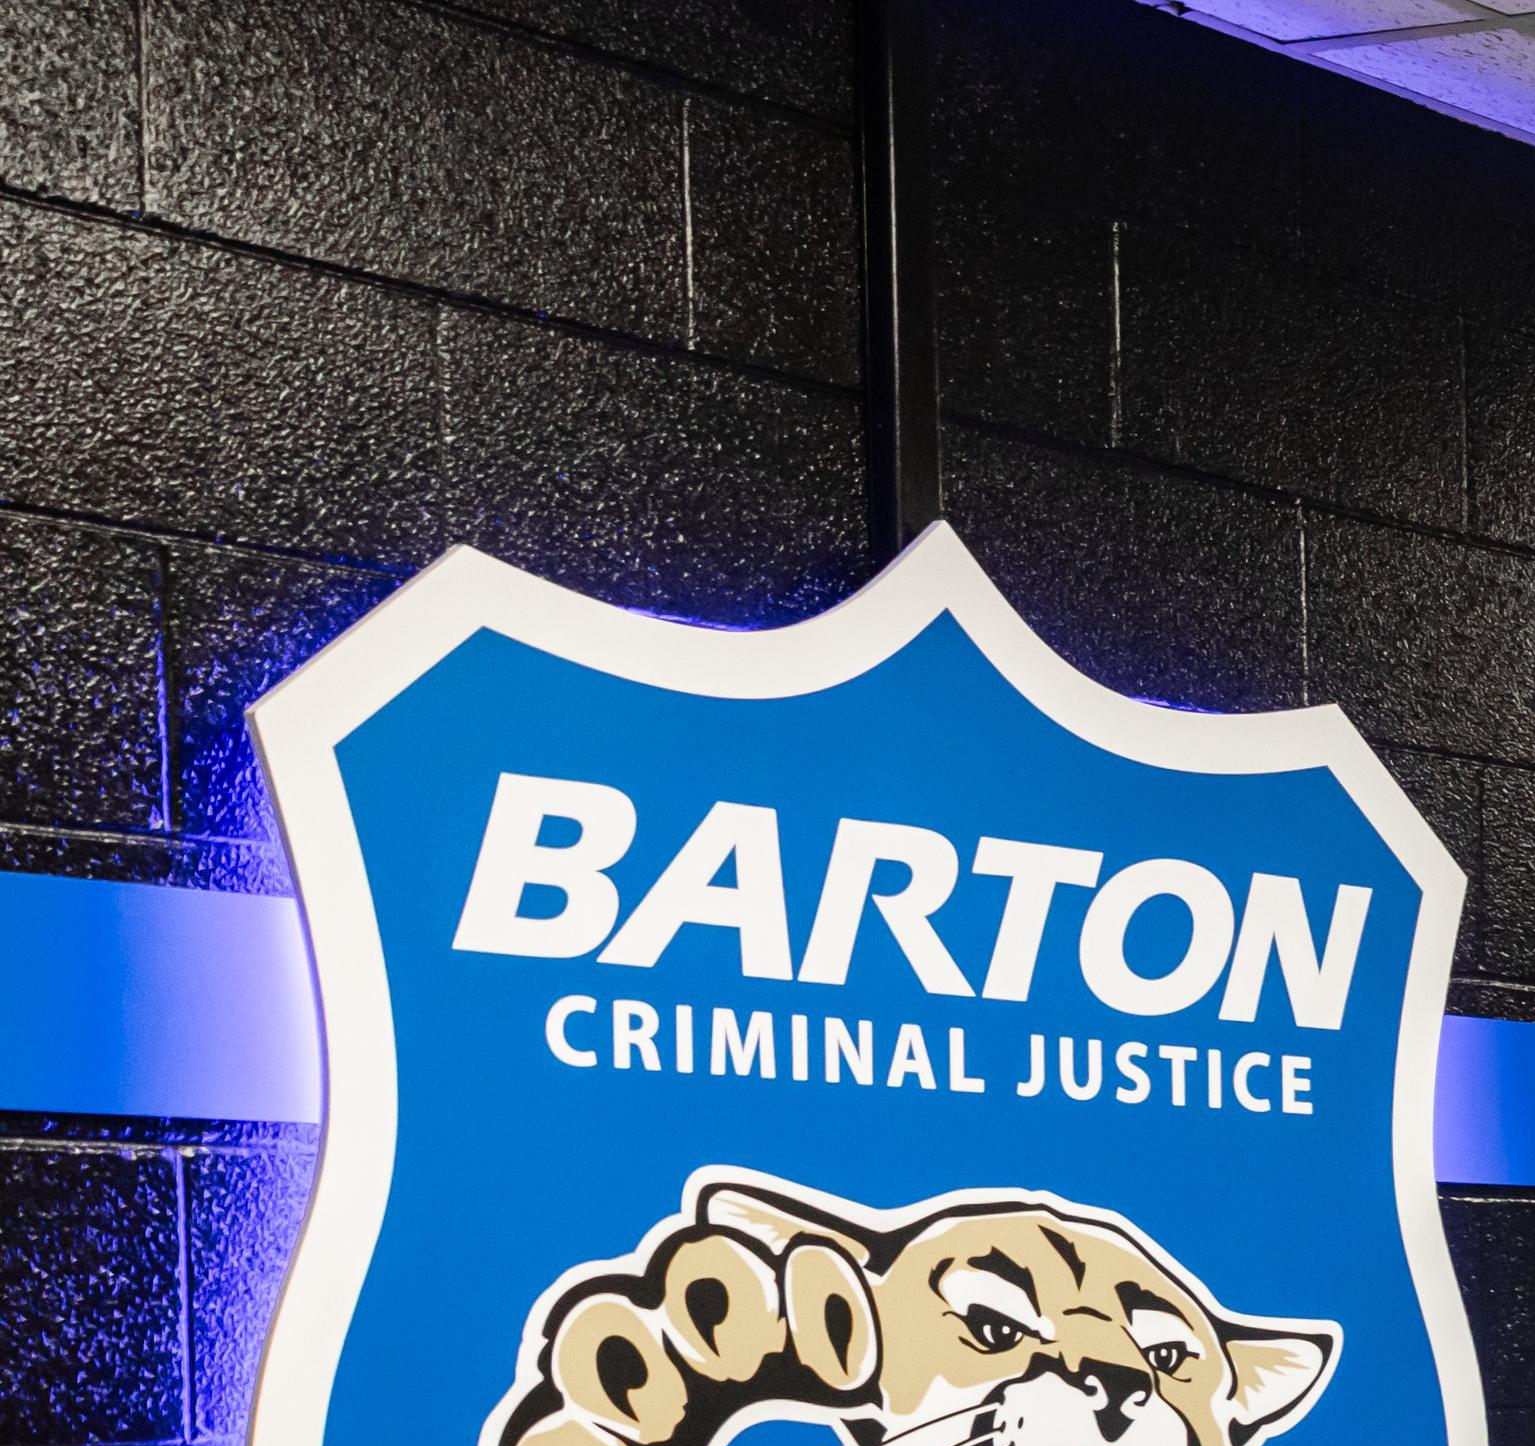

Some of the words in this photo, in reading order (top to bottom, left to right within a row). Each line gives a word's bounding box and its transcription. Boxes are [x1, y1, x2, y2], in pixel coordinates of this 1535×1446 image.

[451, 772, 1373, 1030] BARTON
[545, 994, 985, 1094] CRIMINAL
[1016, 1033, 1314, 1115] JUSTICE
